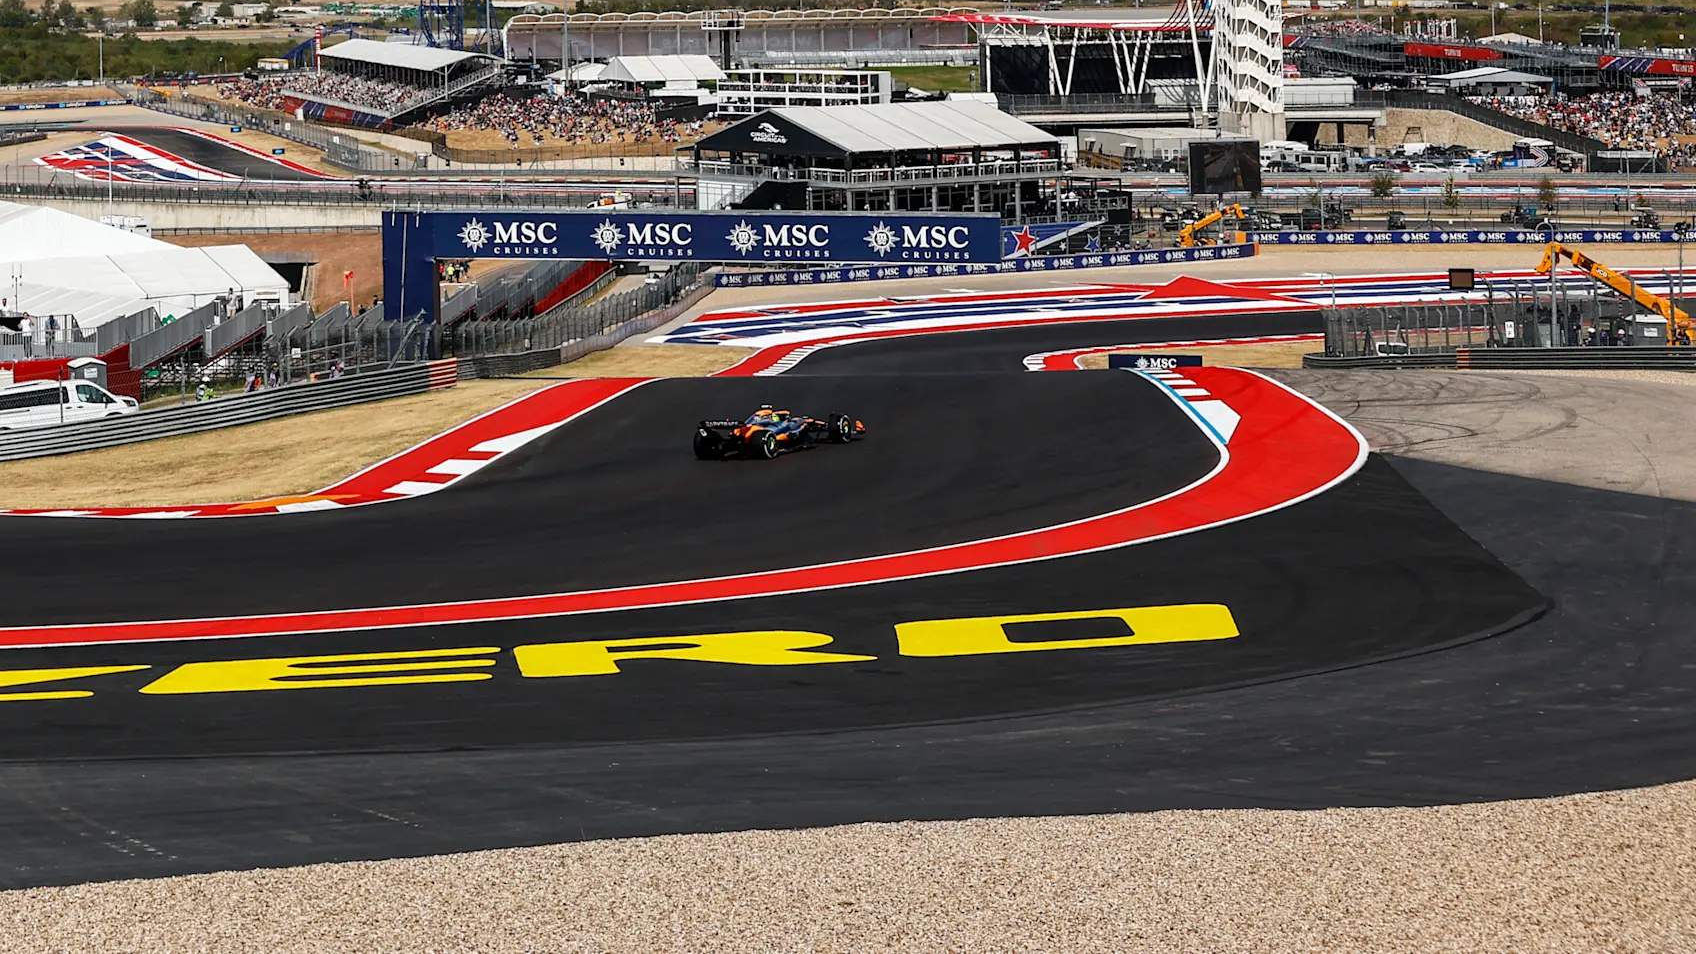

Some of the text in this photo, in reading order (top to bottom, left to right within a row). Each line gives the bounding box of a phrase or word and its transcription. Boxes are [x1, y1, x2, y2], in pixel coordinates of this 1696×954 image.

[493, 221, 558, 244] MSC
[626, 222, 692, 246] MSC
[762, 223, 829, 247] MSC
[901, 225, 970, 248] MSC
[1411, 232, 1430, 240] MSC
[1449, 232, 1468, 240] MSC
[1487, 232, 1506, 240] MSC
[1564, 232, 1583, 240] MSC
[1603, 232, 1622, 240] MSC
[1642, 232, 1661, 240] MSC
[1260, 233, 1279, 241] MSC
[1298, 233, 1316, 241] MSC
[1335, 233, 1354, 241] MSC
[1374, 233, 1392, 241] MSC
[494, 246, 558, 255] CRUISES
[627, 248, 693, 256] CRUISES
[763, 249, 830, 258] CRUISES
[1199, 249, 1214, 257] MSC
[1226, 247, 1240, 255] MSC
[902, 251, 970, 260] CRUISES
[1116, 254, 1131, 263] MSC
[1144, 253, 1159, 261] MSC
[1172, 251, 1186, 259] MSC
[1031, 259, 1045, 267] MSC
[1059, 257, 1074, 266] MSC
[1087, 256, 1103, 264] MSC
[1002, 261, 1016, 269] MSC
[855, 269, 870, 277] MSC
[884, 267, 899, 276] MSC
[913, 266, 928, 274] MSC
[728, 275, 742, 283] MSC
[775, 273, 787, 281] MSC
[799, 272, 813, 281] MSC
[826, 271, 841, 279] MSC
[1150, 358, 1177, 368] MSC
